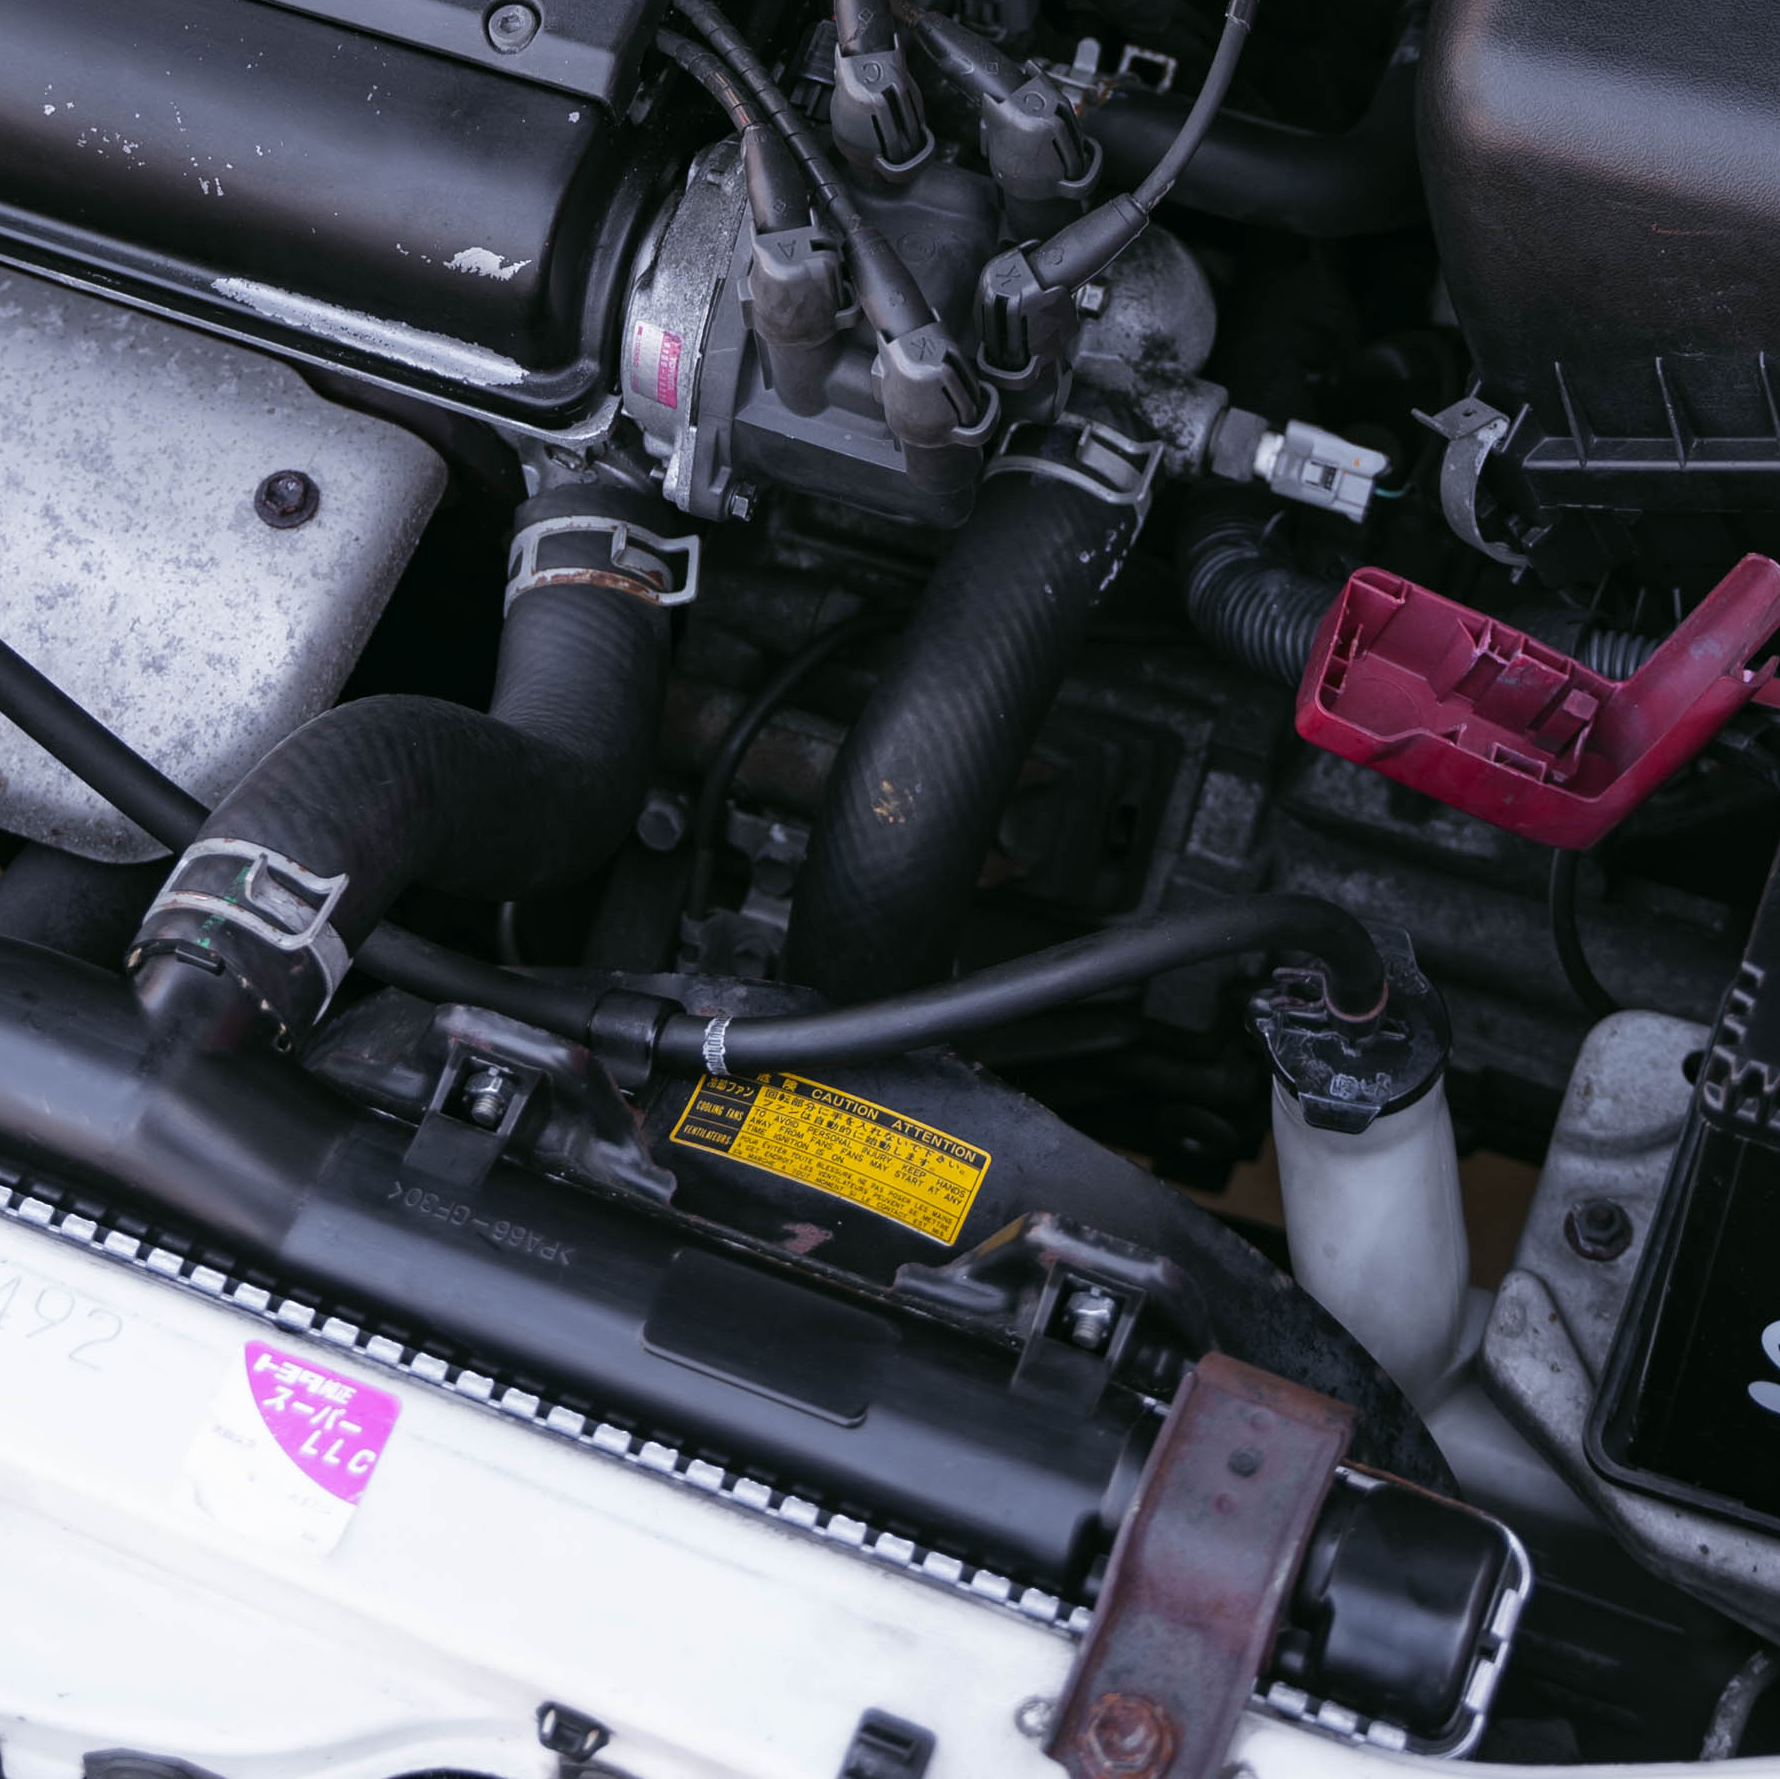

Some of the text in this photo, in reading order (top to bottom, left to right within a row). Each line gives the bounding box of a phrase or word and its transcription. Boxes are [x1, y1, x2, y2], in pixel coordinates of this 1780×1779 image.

[695, 1099, 745, 1122] COOLING FANS
[811, 1088, 977, 1163] CAUTION ATTENTION
[683, 1124, 732, 1146] VENTILATEURS
[745, 1122, 825, 1156] TIME IGNITION IS
[753, 1107, 967, 1199] TO AVOID PERSONAL KEEP HANDS
[749, 1115, 773, 1130] AWAY
[778, 1124, 805, 1140] FROM
[839, 1147, 864, 1162] FANS
[868, 1159, 889, 1172] MAY
[892, 1169, 924, 1188] START
[926, 1184, 941, 1196] AT
[942, 1192, 962, 1206] ANY
[744, 1143, 950, 1232] CET LES VENTILATEURS PEUVENT SE METTRE
[790, 1150, 954, 1225] TOUTE NE PAS POSER LES MAINS
[814, 1176, 907, 1219] MOMENT CONTACT
[261, 1386, 363, 1434] スーパー
[299, 1429, 377, 1474] LLC
